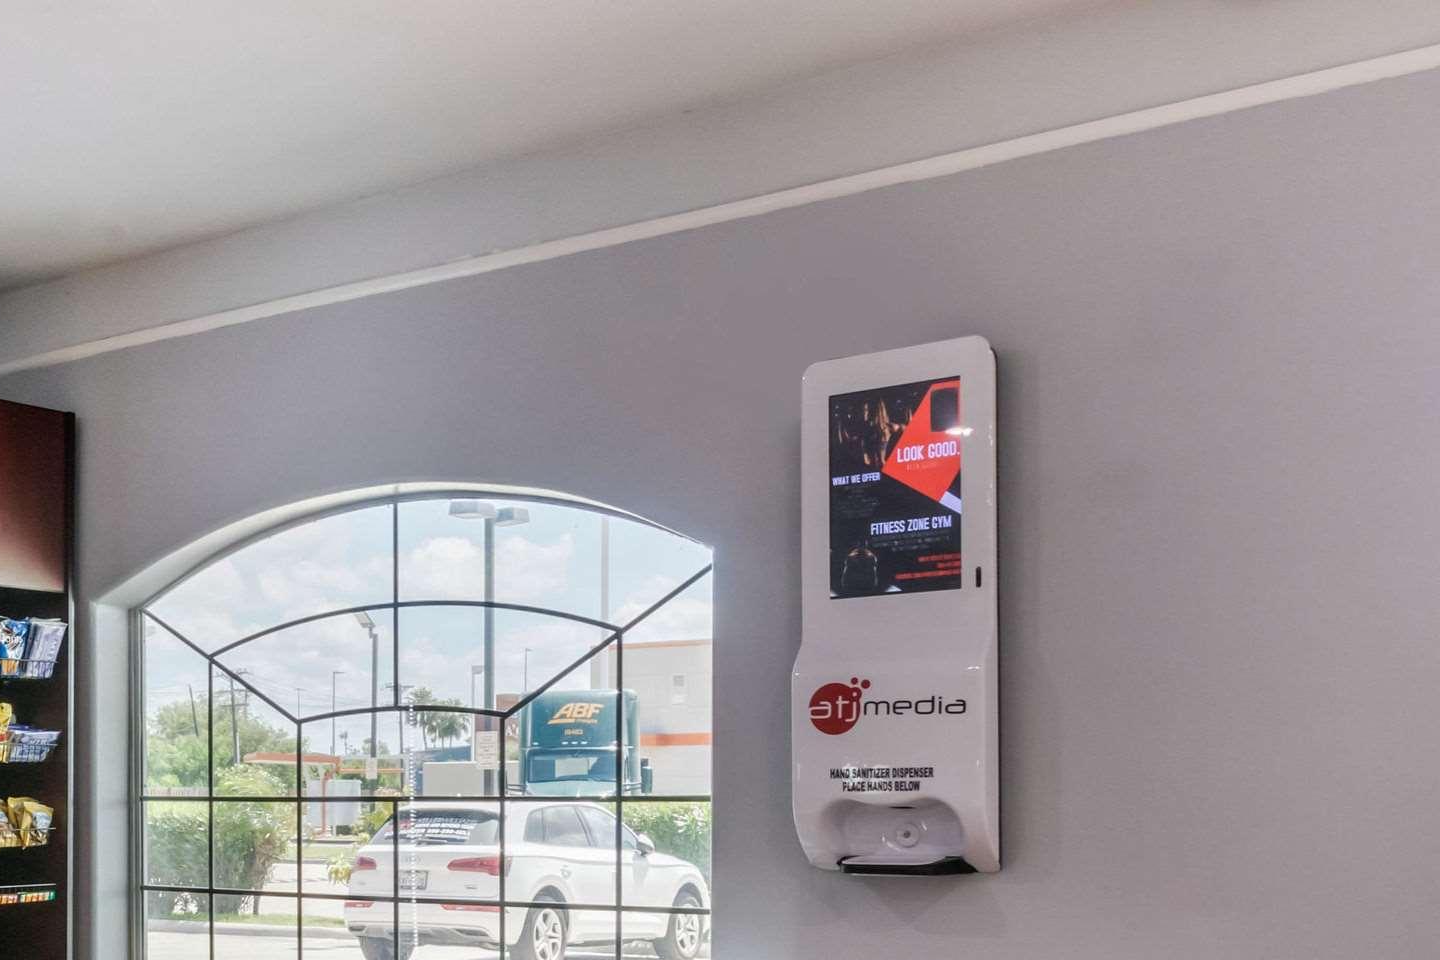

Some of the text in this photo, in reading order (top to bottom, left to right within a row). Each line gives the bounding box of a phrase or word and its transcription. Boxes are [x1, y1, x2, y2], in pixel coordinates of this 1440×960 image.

[896, 444, 924, 463] LOOK
[861, 472, 881, 483] OFFER
[870, 514, 952, 536] FITNESS ZONE GYM
[552, 702, 605, 719] ABF
[829, 766, 934, 779] HAND SANITIZER DISPENSER
[842, 780, 920, 792] PLACE HANDS BELOW
